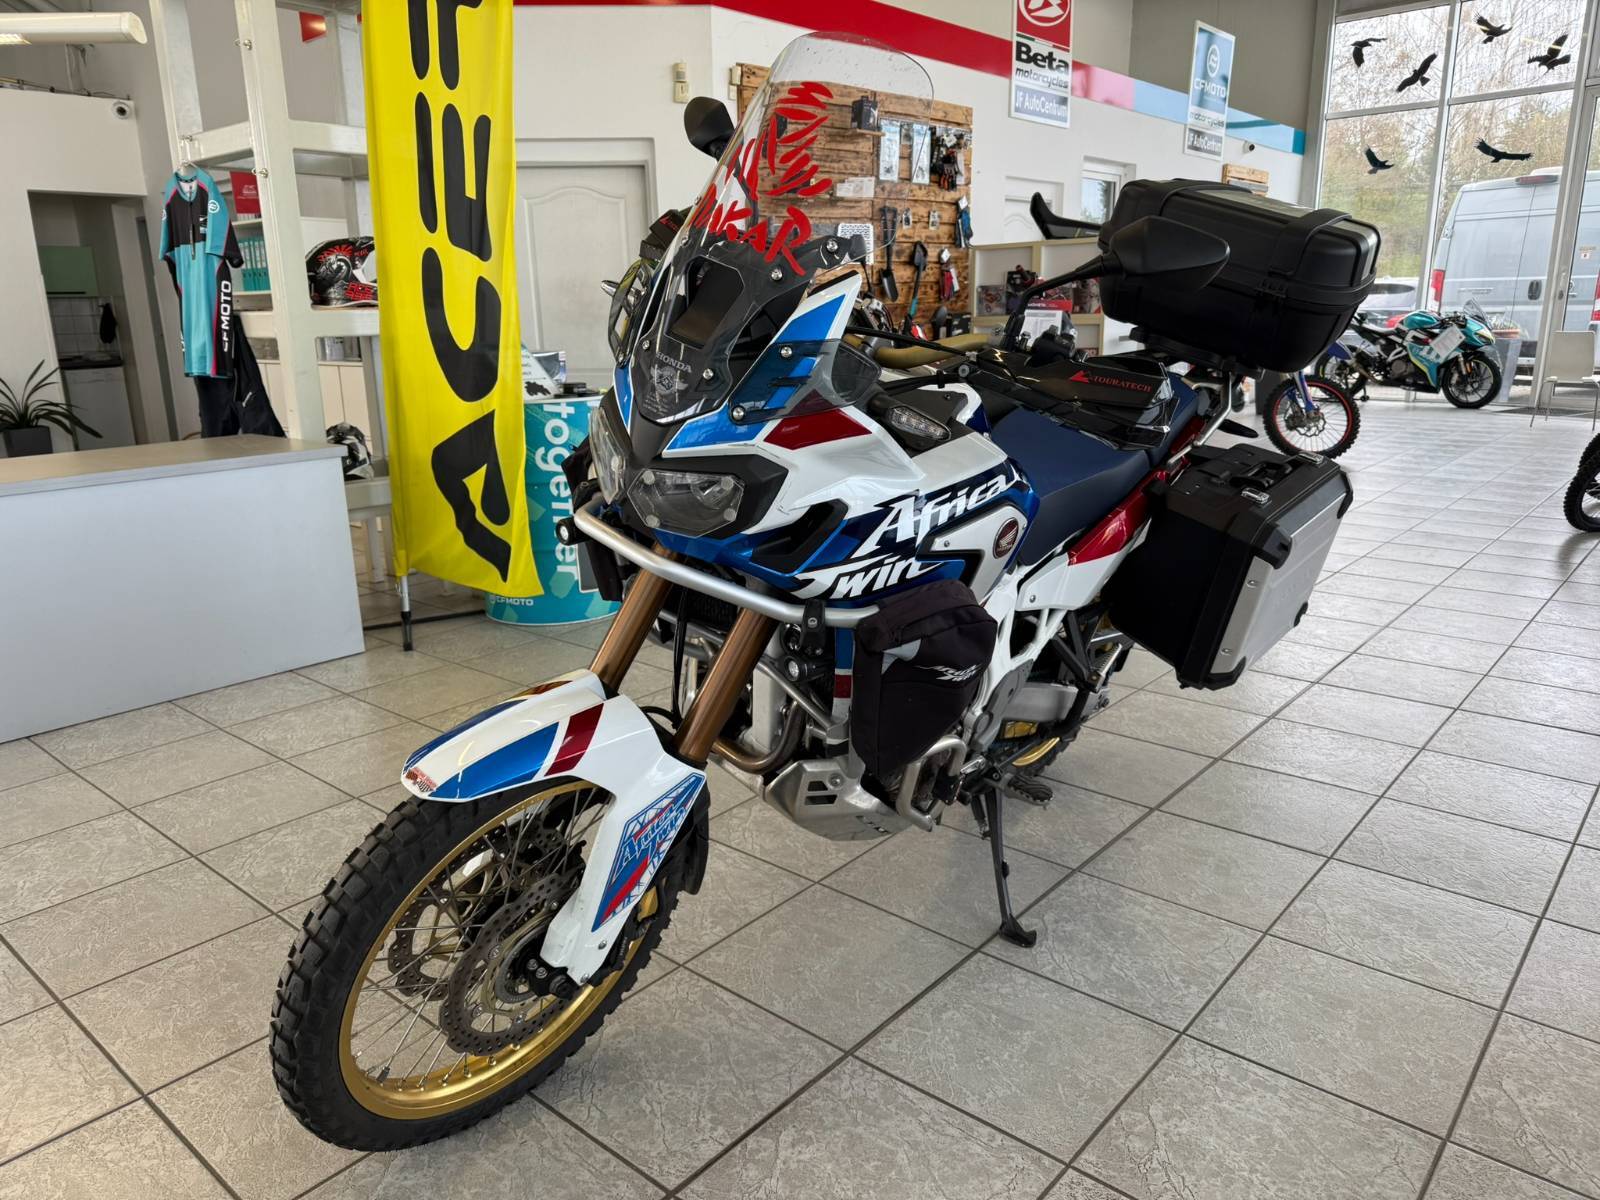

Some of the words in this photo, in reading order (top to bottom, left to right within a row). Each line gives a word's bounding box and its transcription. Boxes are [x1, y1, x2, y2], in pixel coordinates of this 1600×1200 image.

[1016, 41, 1069, 75] Beta
[1016, 67, 1069, 88] motorcycles
[1194, 78, 1226, 98] CFMOTO
[1016, 91, 1023, 108] JF
[1024, 96, 1068, 117] AutoCentrum
[655, 351, 692, 373] HONDA
[1093, 375, 1153, 392] TOURATECH
[850, 472, 1020, 558] Africa
[790, 552, 943, 600] Twin
